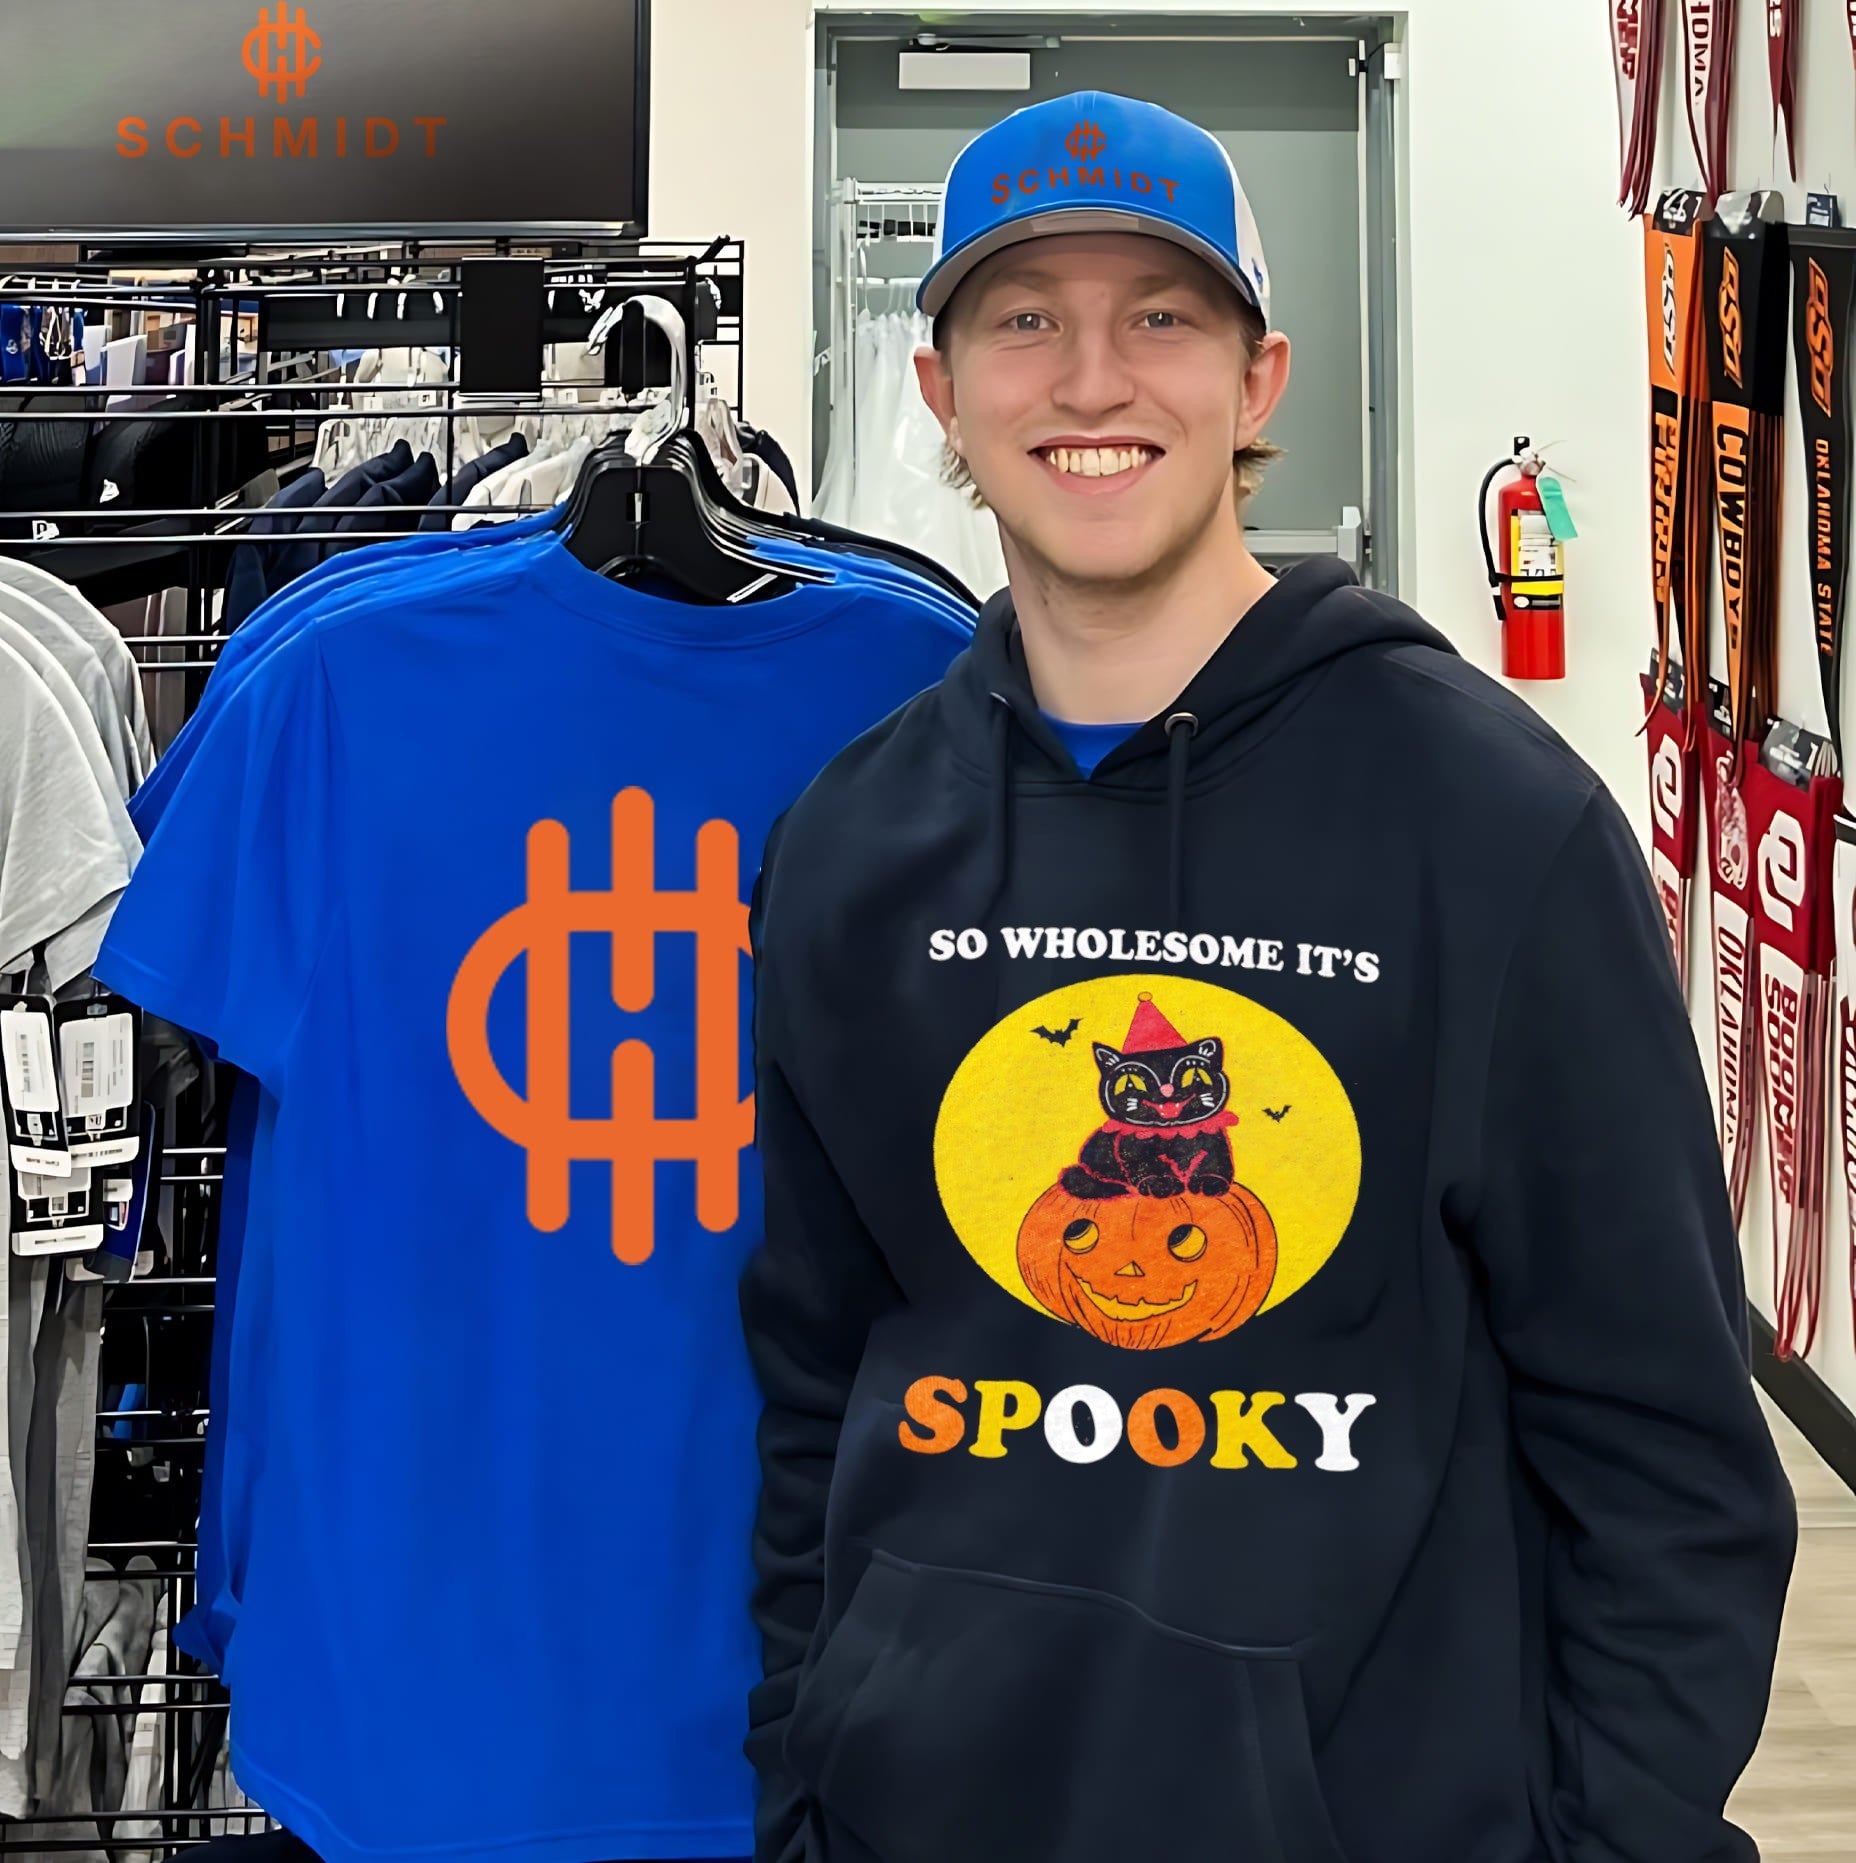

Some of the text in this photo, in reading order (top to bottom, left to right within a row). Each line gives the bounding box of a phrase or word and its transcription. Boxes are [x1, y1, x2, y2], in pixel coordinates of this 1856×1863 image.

[115, 116, 448, 158] SCHMIDT
[991, 167, 1180, 205] SCHMIDT
[1815, 438, 1835, 657] OKLAHOMA STATE
[928, 927, 1381, 984] SO WHOLESOME IT'S
[1718, 926, 1745, 1144] OKLAHOMA
[898, 1375, 1377, 1472] SPOOKY
